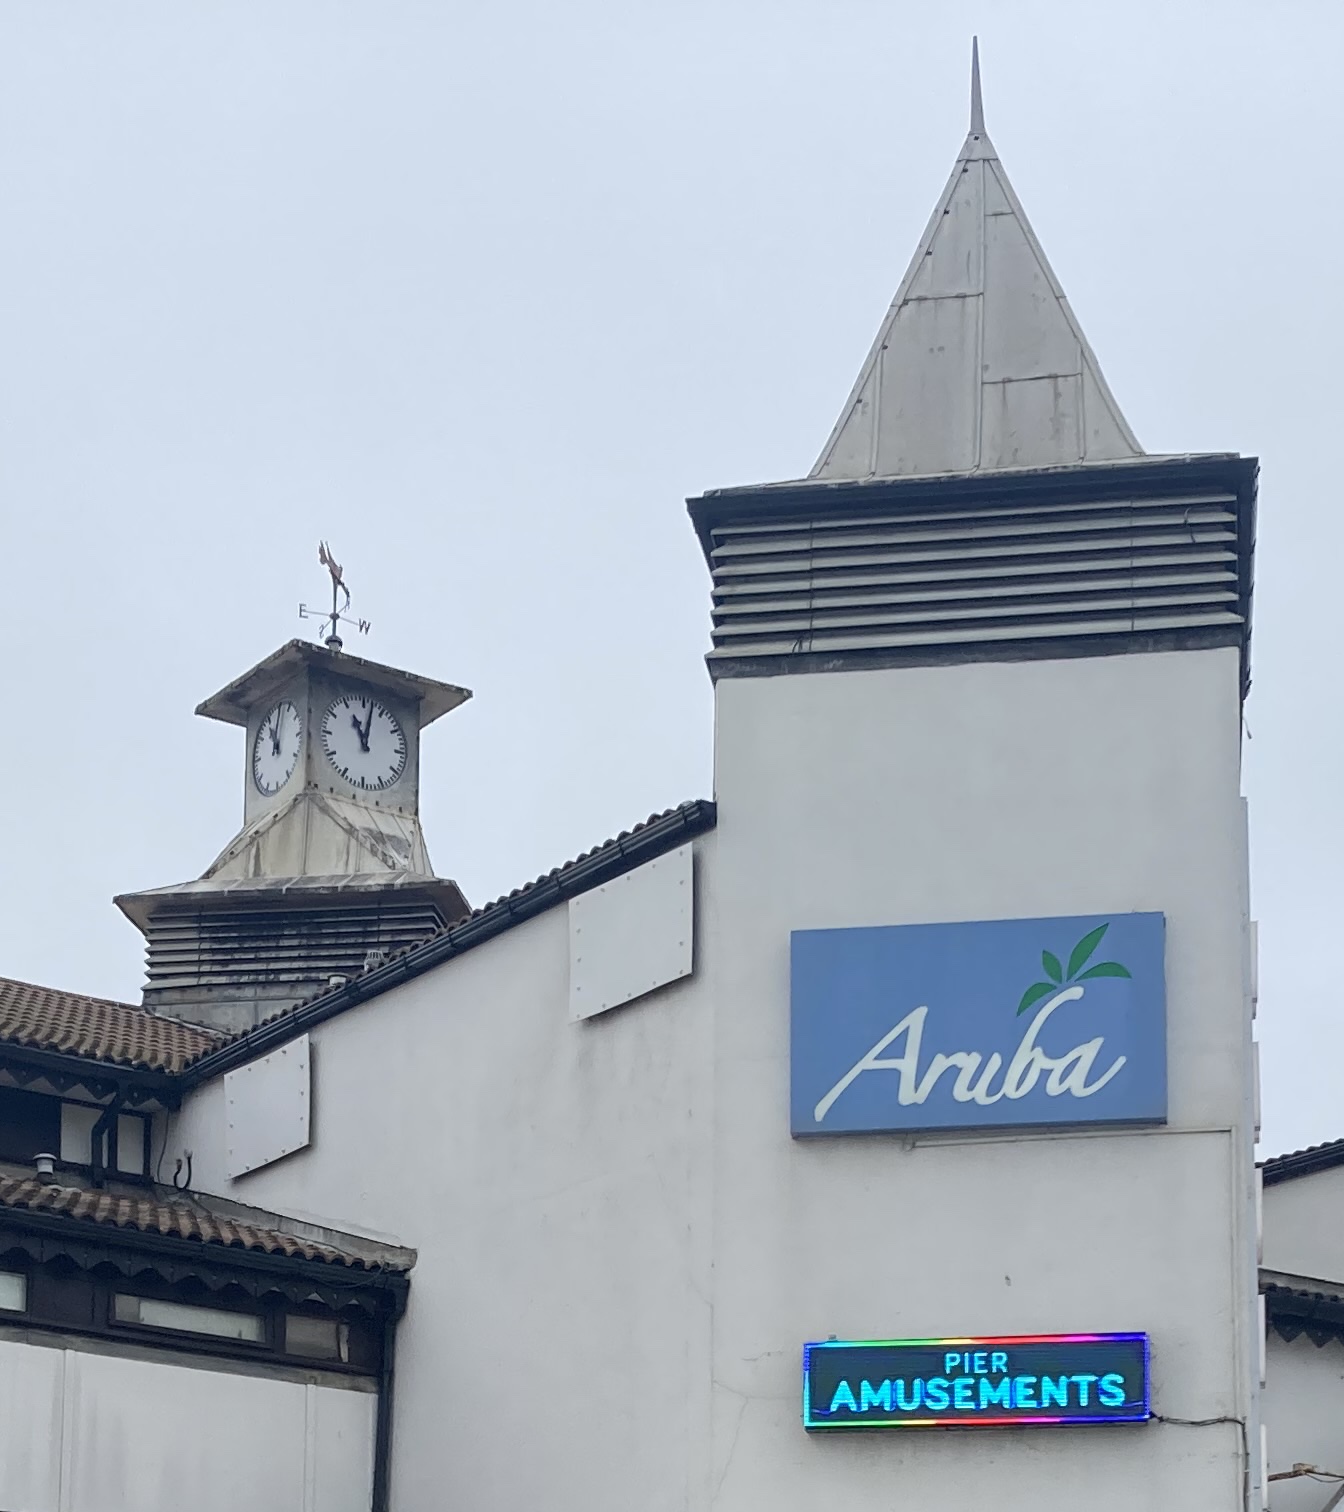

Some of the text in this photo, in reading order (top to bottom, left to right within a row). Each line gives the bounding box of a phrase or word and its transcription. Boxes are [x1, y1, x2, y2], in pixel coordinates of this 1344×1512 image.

[813, 985, 1127, 1123] Aruba
[944, 1351, 1009, 1375] PIER
[829, 1374, 1127, 1413] AMUSEMENTS
